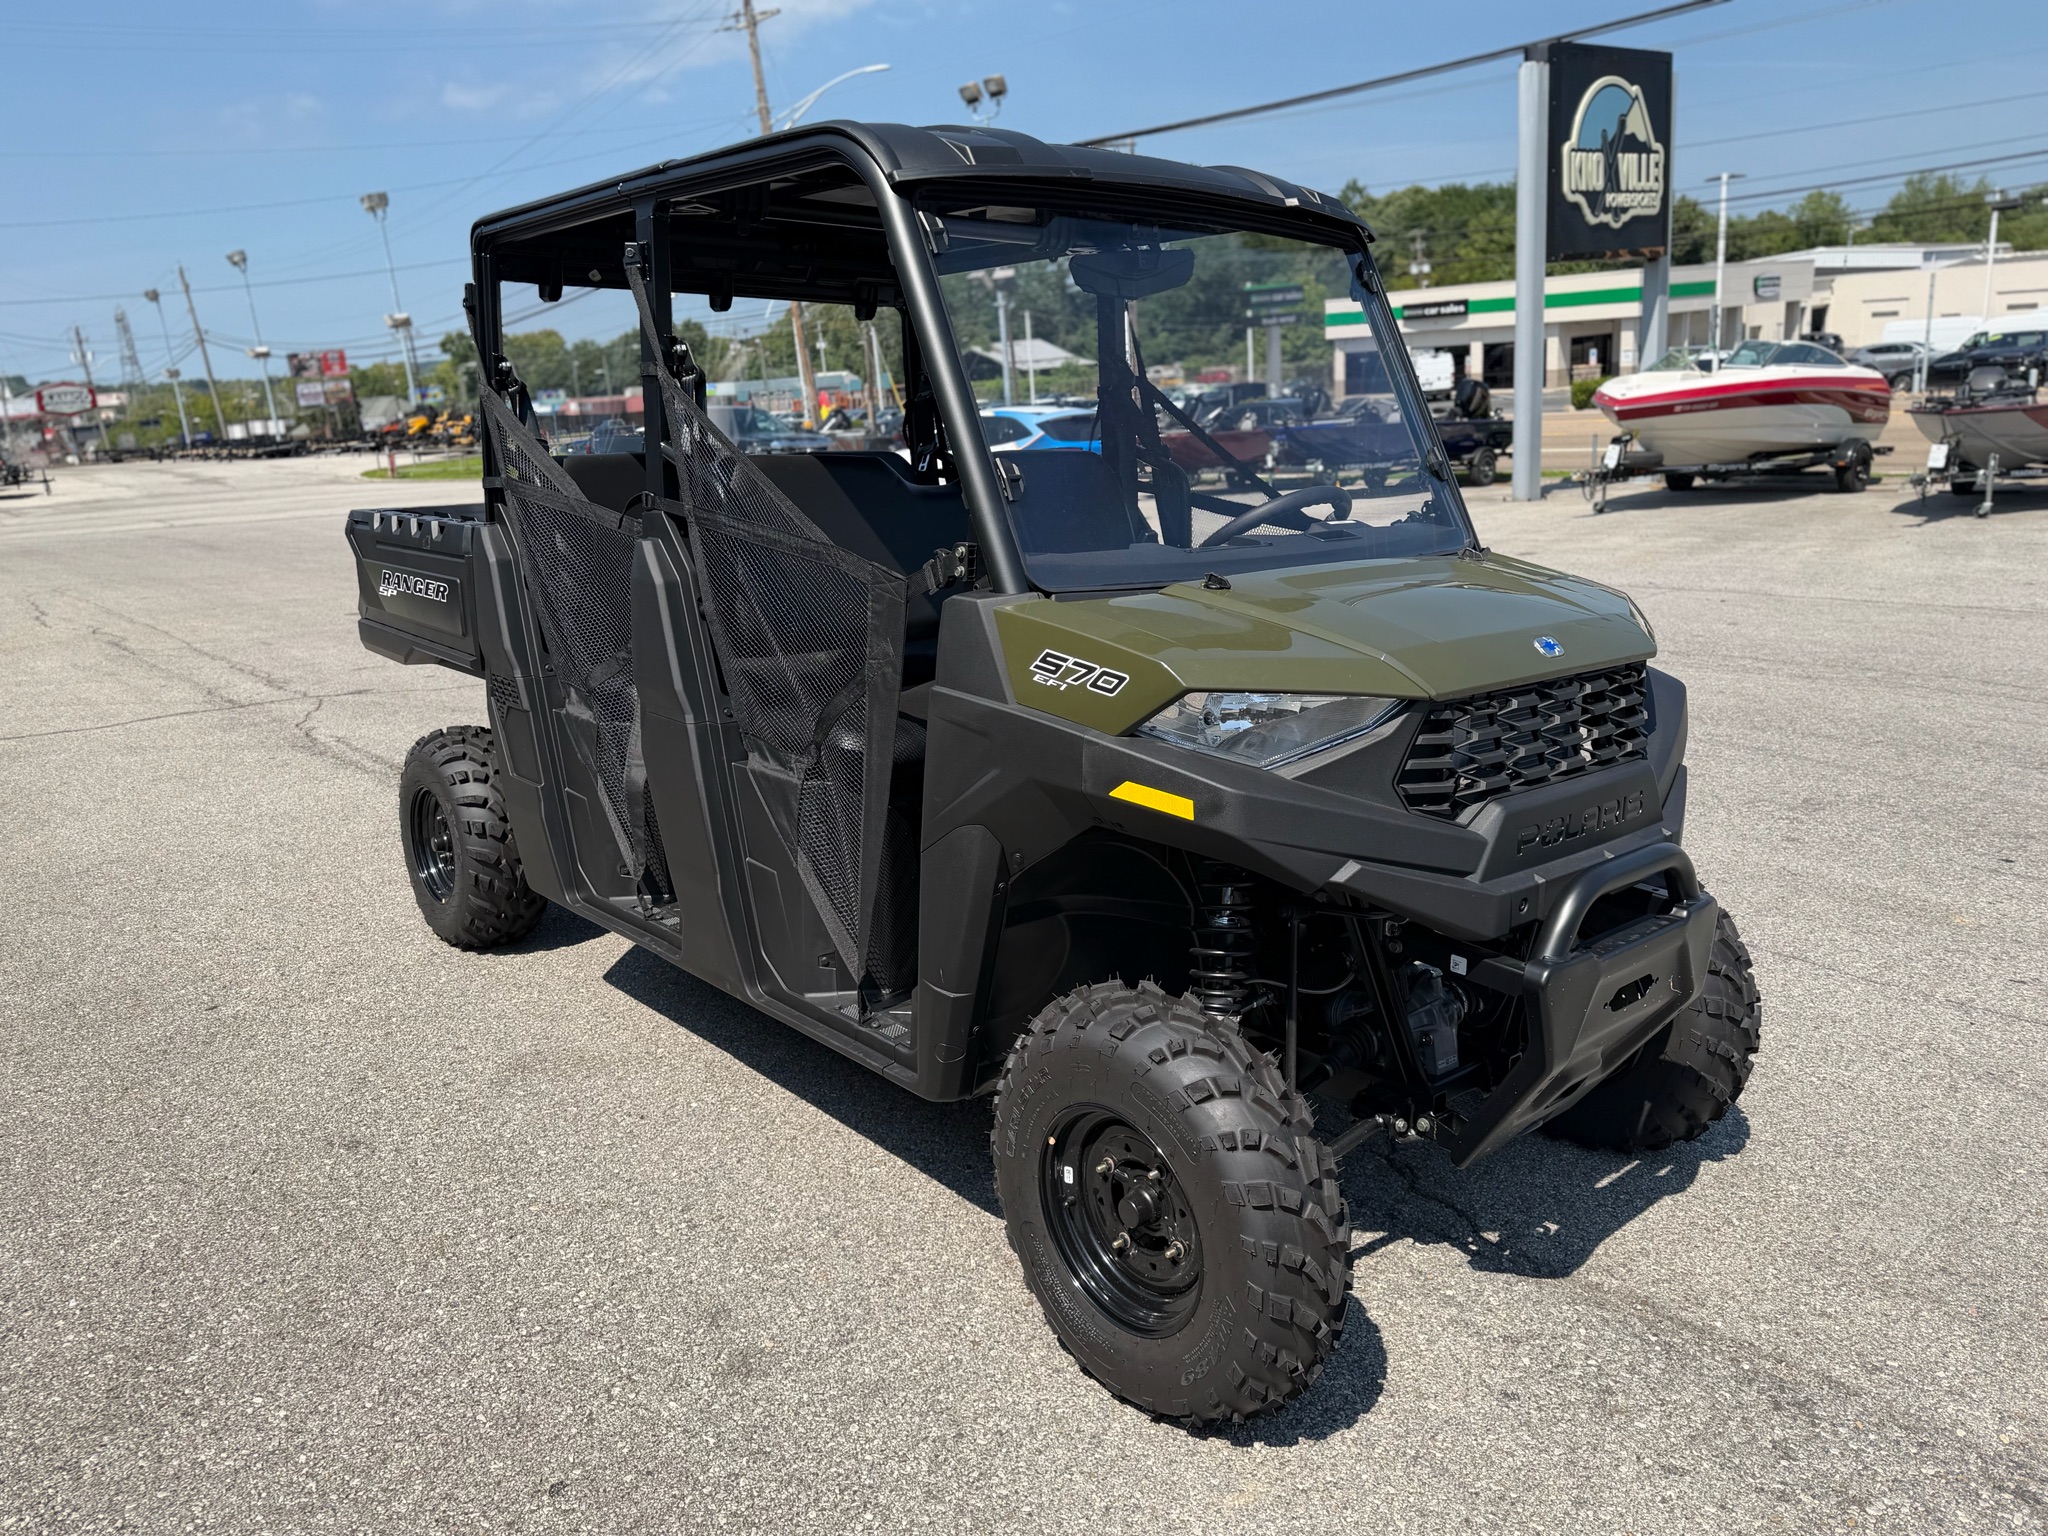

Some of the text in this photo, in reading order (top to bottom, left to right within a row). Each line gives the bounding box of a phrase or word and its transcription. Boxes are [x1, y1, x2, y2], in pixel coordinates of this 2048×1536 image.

[1570, 151, 1660, 191] KNOXVILLE
[379, 586, 398, 597] SP
[381, 570, 448, 603] RANGER
[1029, 648, 1130, 697] 570
[1032, 673, 1068, 691] EFI
[1516, 789, 1643, 857] POLARIS
